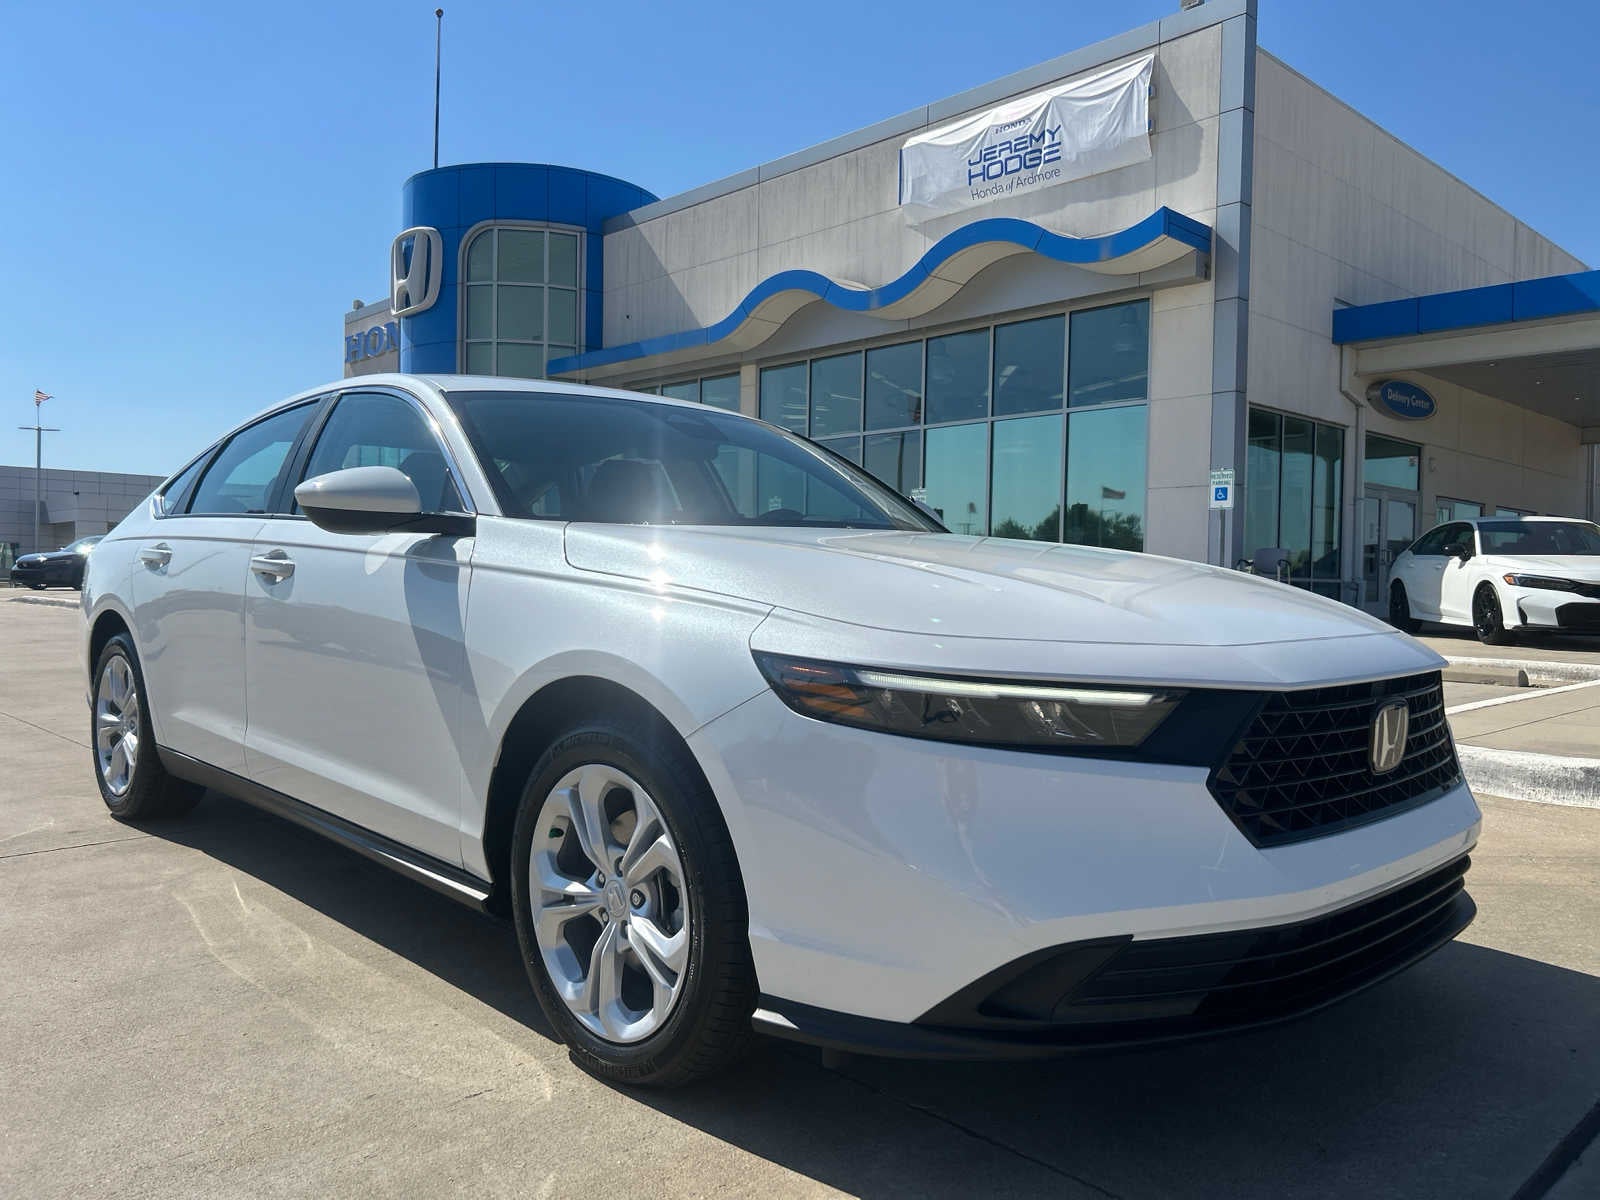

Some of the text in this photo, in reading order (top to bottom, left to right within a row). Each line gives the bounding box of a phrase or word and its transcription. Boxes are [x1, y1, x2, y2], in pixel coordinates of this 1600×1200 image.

[968, 124, 1062, 167] JEREMY
[968, 141, 1062, 187] HODGE
[971, 168, 1061, 200] Honda of Ardmore
